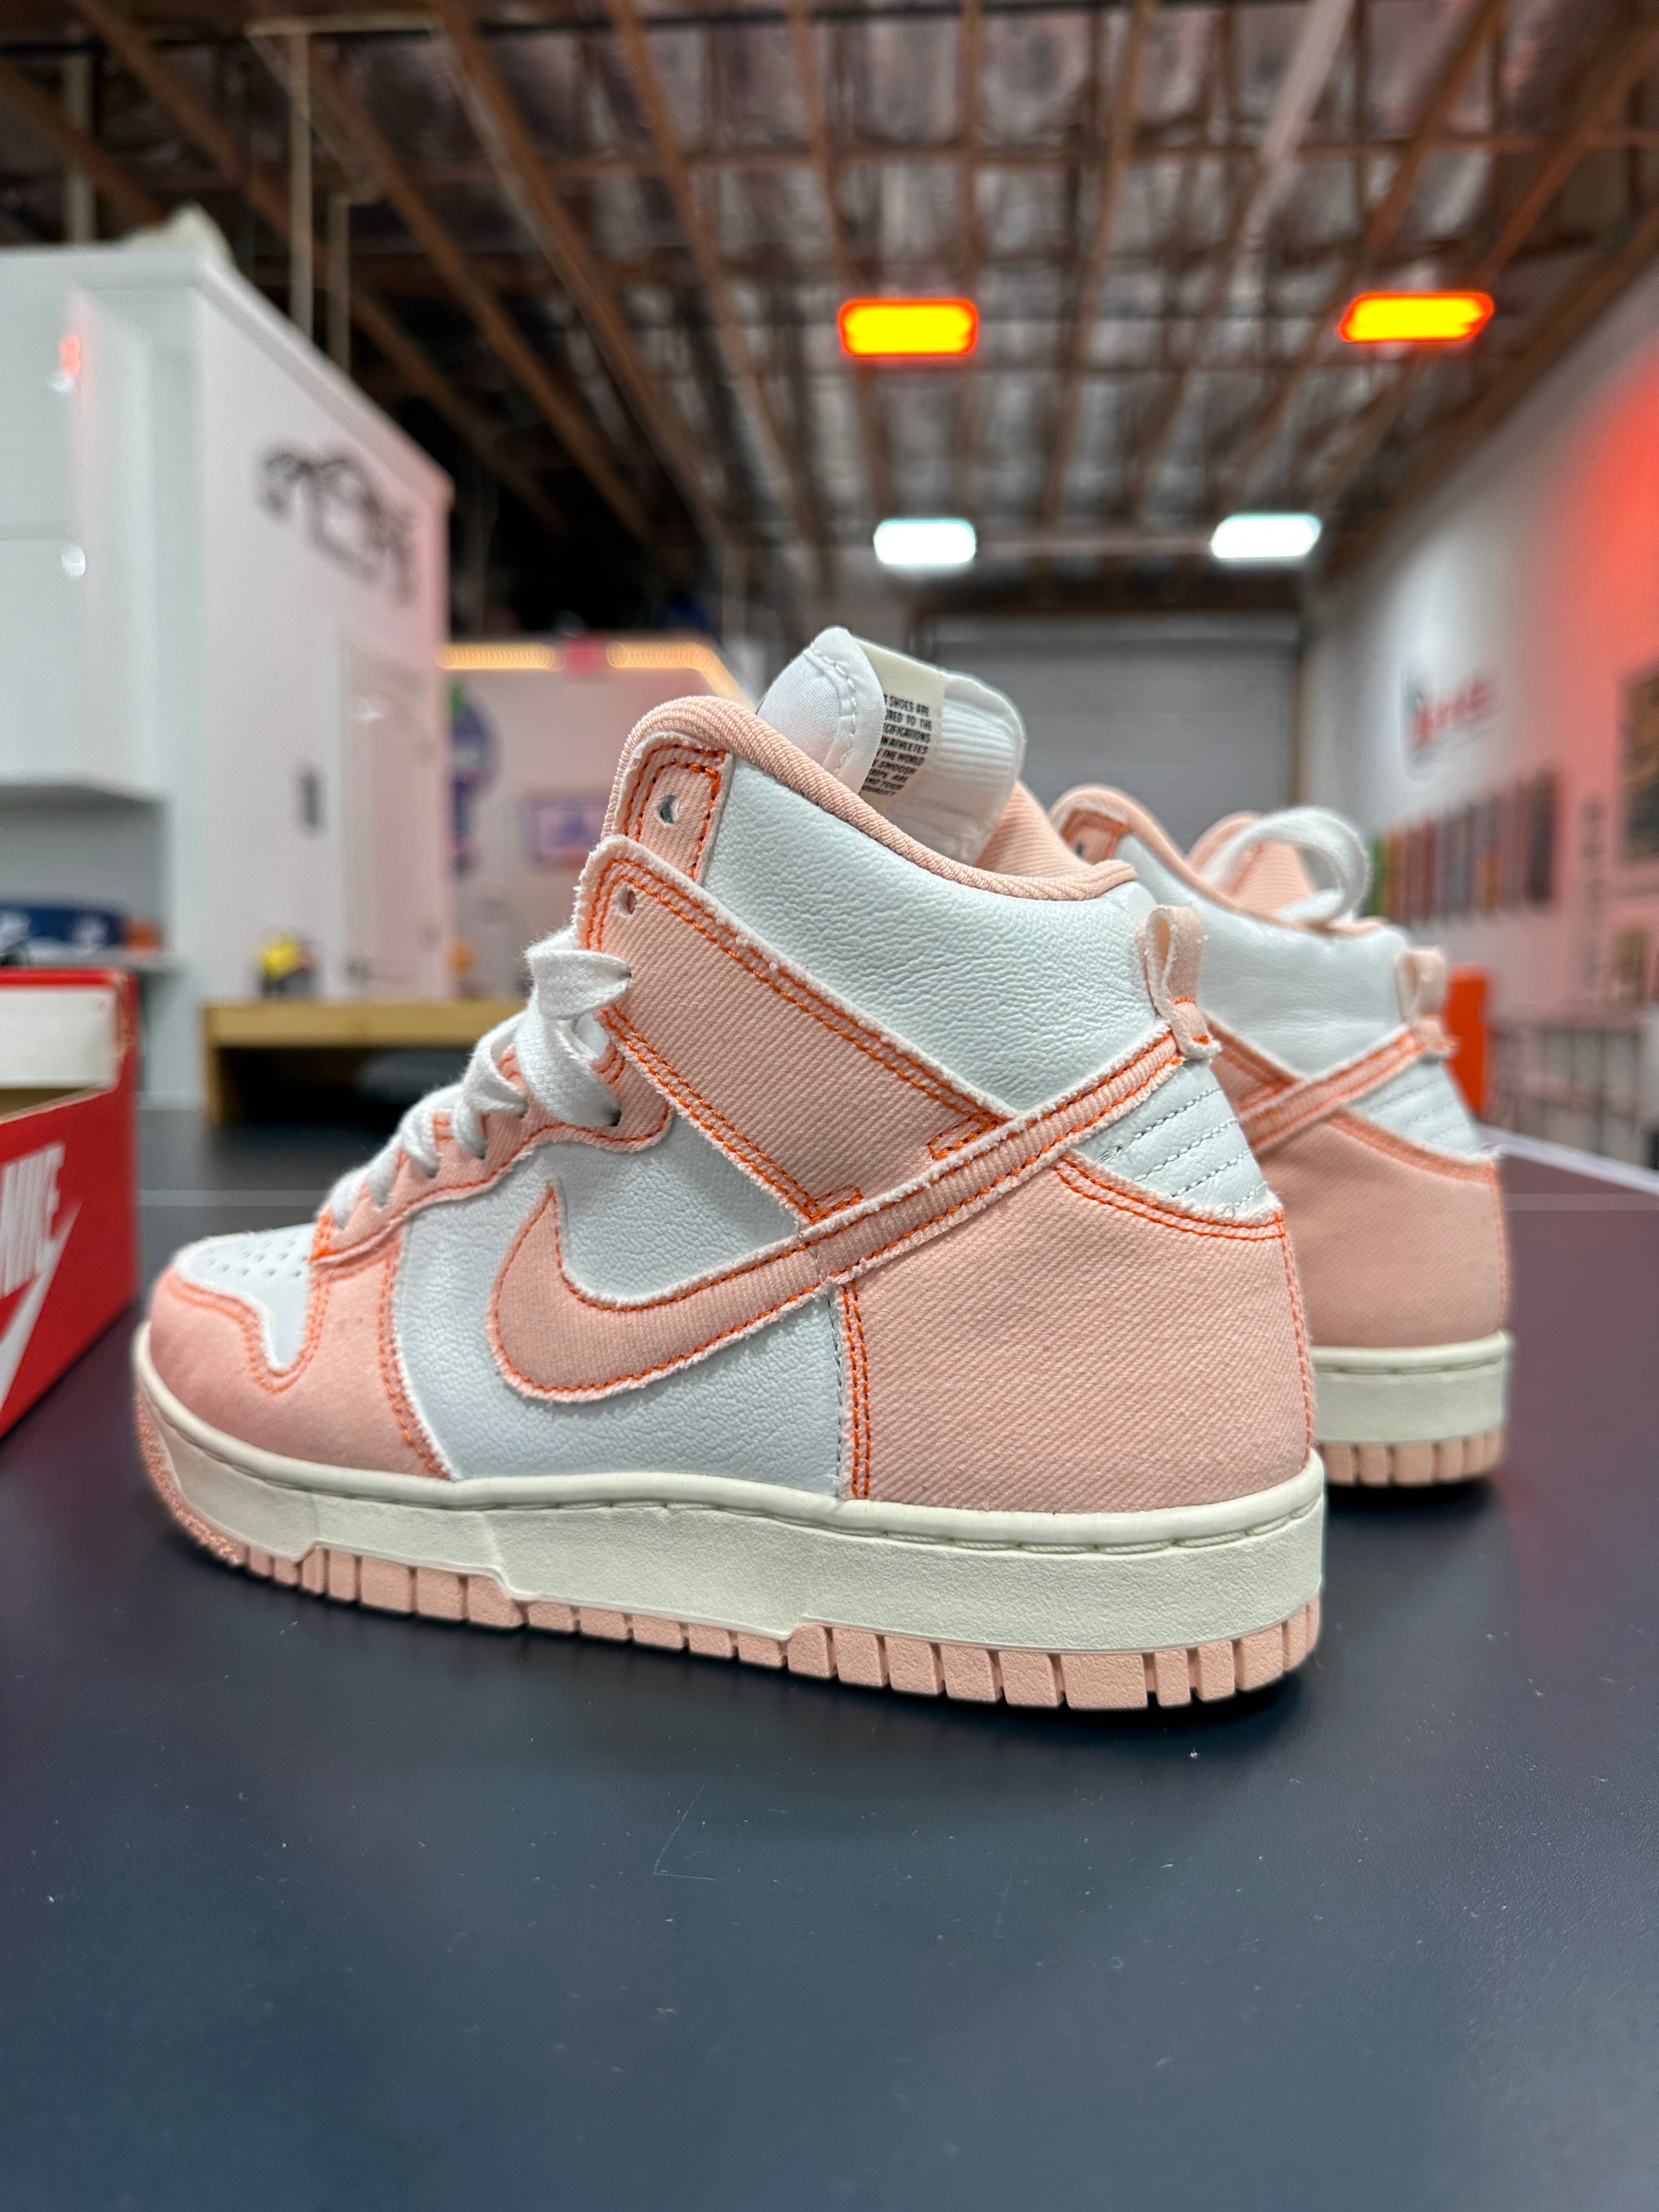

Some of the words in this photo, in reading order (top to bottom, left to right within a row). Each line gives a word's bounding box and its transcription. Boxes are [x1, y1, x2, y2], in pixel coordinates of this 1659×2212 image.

[889, 696, 914, 713] SHOES
[916, 704, 929, 718] ARE
[907, 715, 916, 726] TO
[920, 719, 932, 731] THE
[889, 738, 928, 754] ATHLETES
[882, 749, 897, 760] THE
[897, 753, 925, 766] WORLD
[879, 761, 917, 775] SWOOSH
[891, 775, 909, 783] ARE
